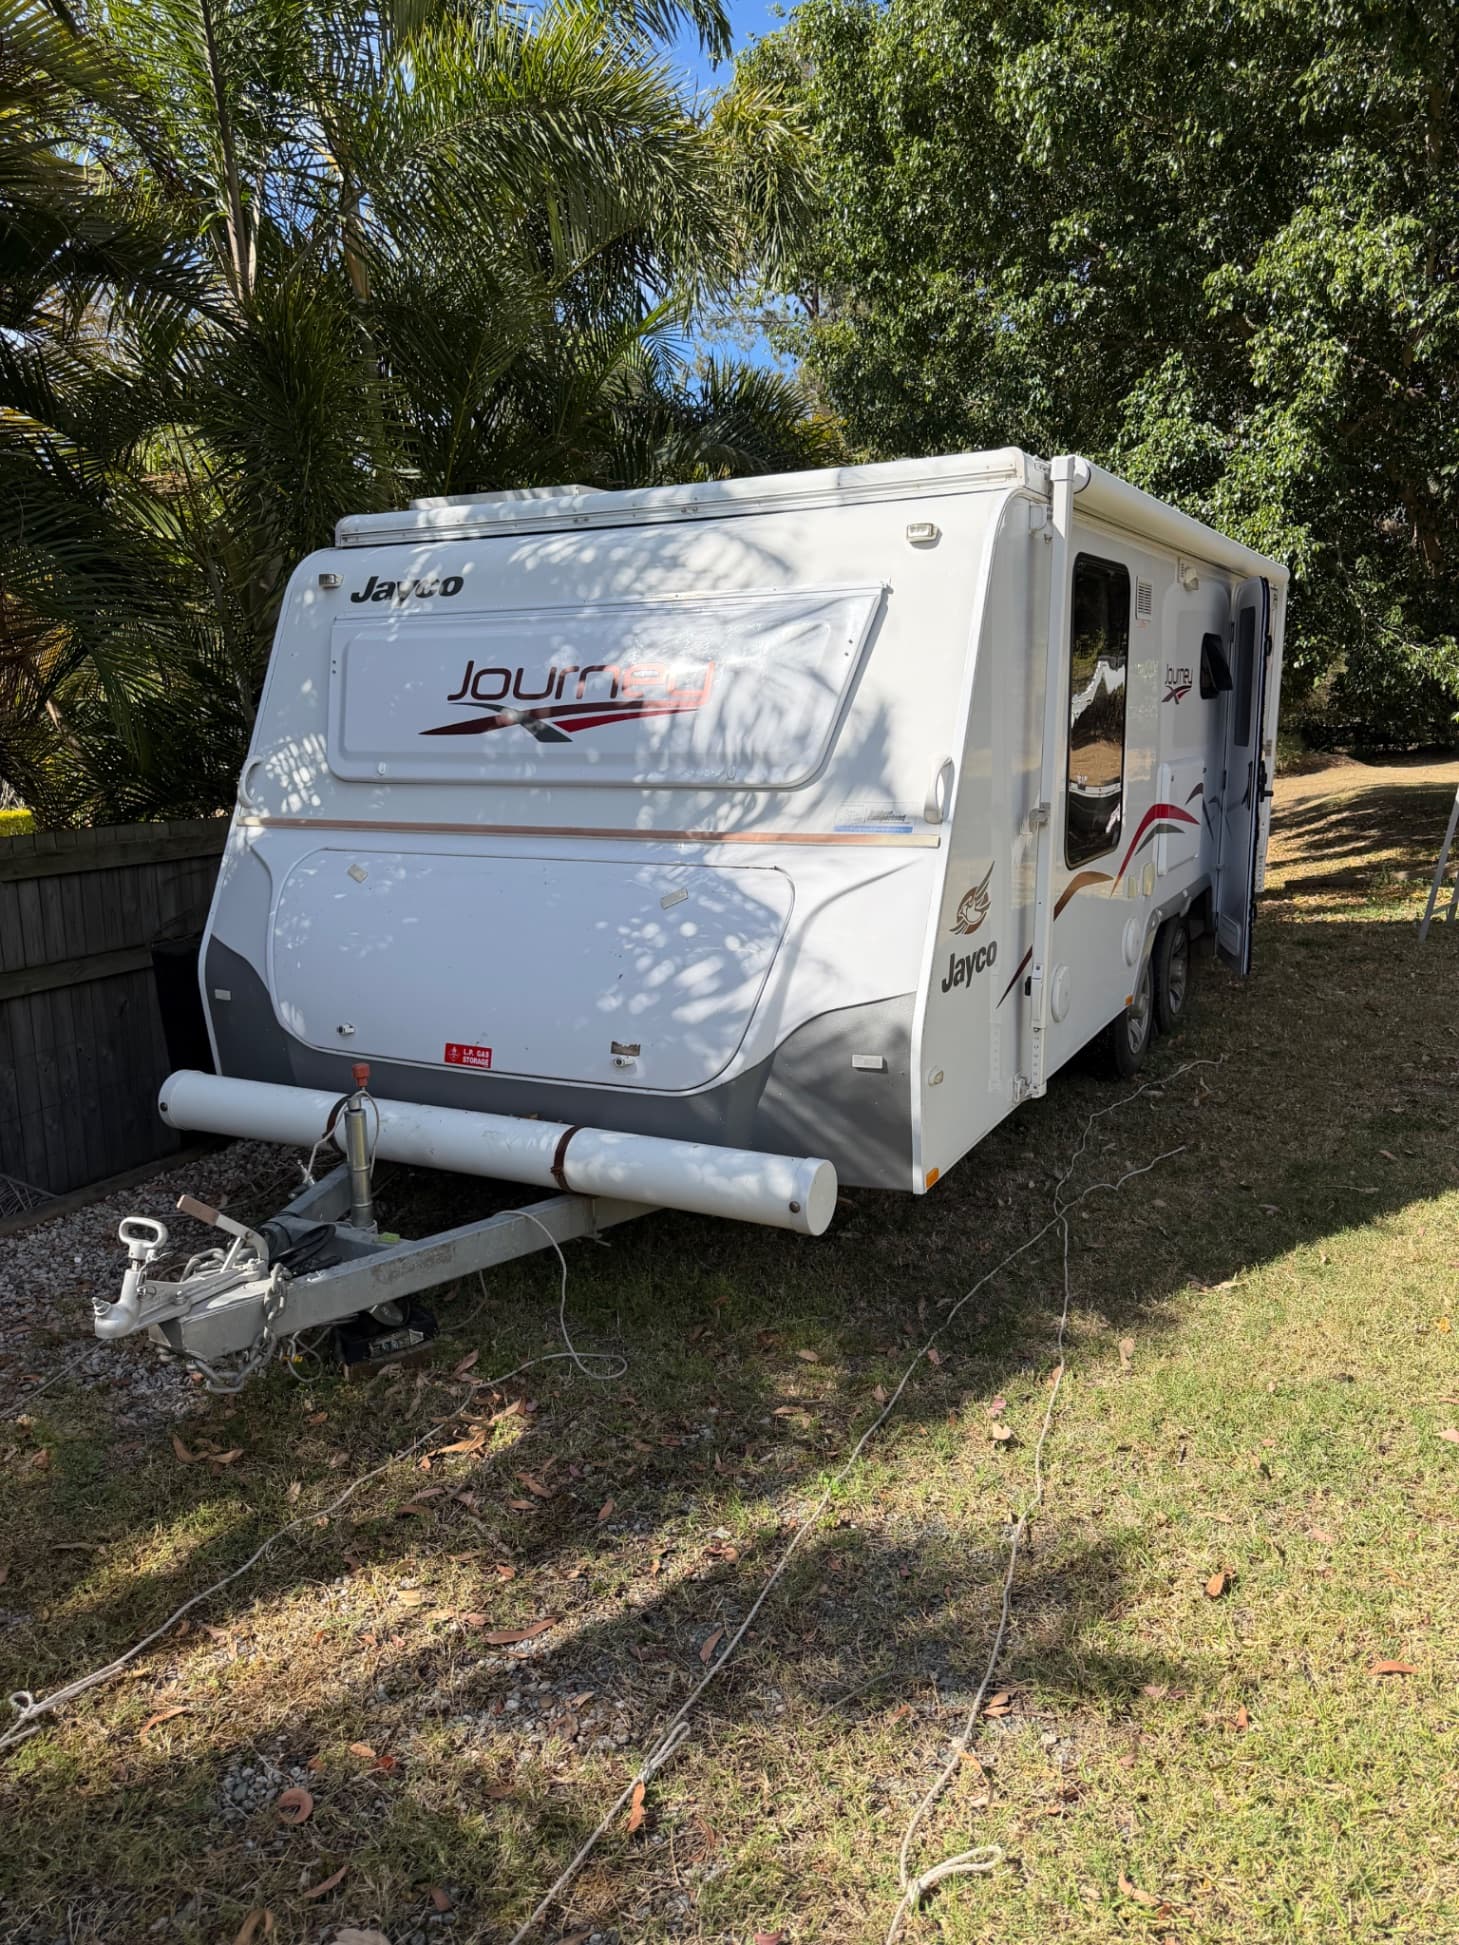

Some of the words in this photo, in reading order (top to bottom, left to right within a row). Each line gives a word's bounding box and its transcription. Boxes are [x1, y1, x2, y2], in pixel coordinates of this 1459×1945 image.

[350, 575, 465, 607] Jayco
[447, 659, 716, 708] Journey
[1164, 663, 1194, 685] Journey
[941, 940, 998, 994] Jayco
[462, 1056, 490, 1068] STORAGE
[476, 1049, 490, 1059] GAS
